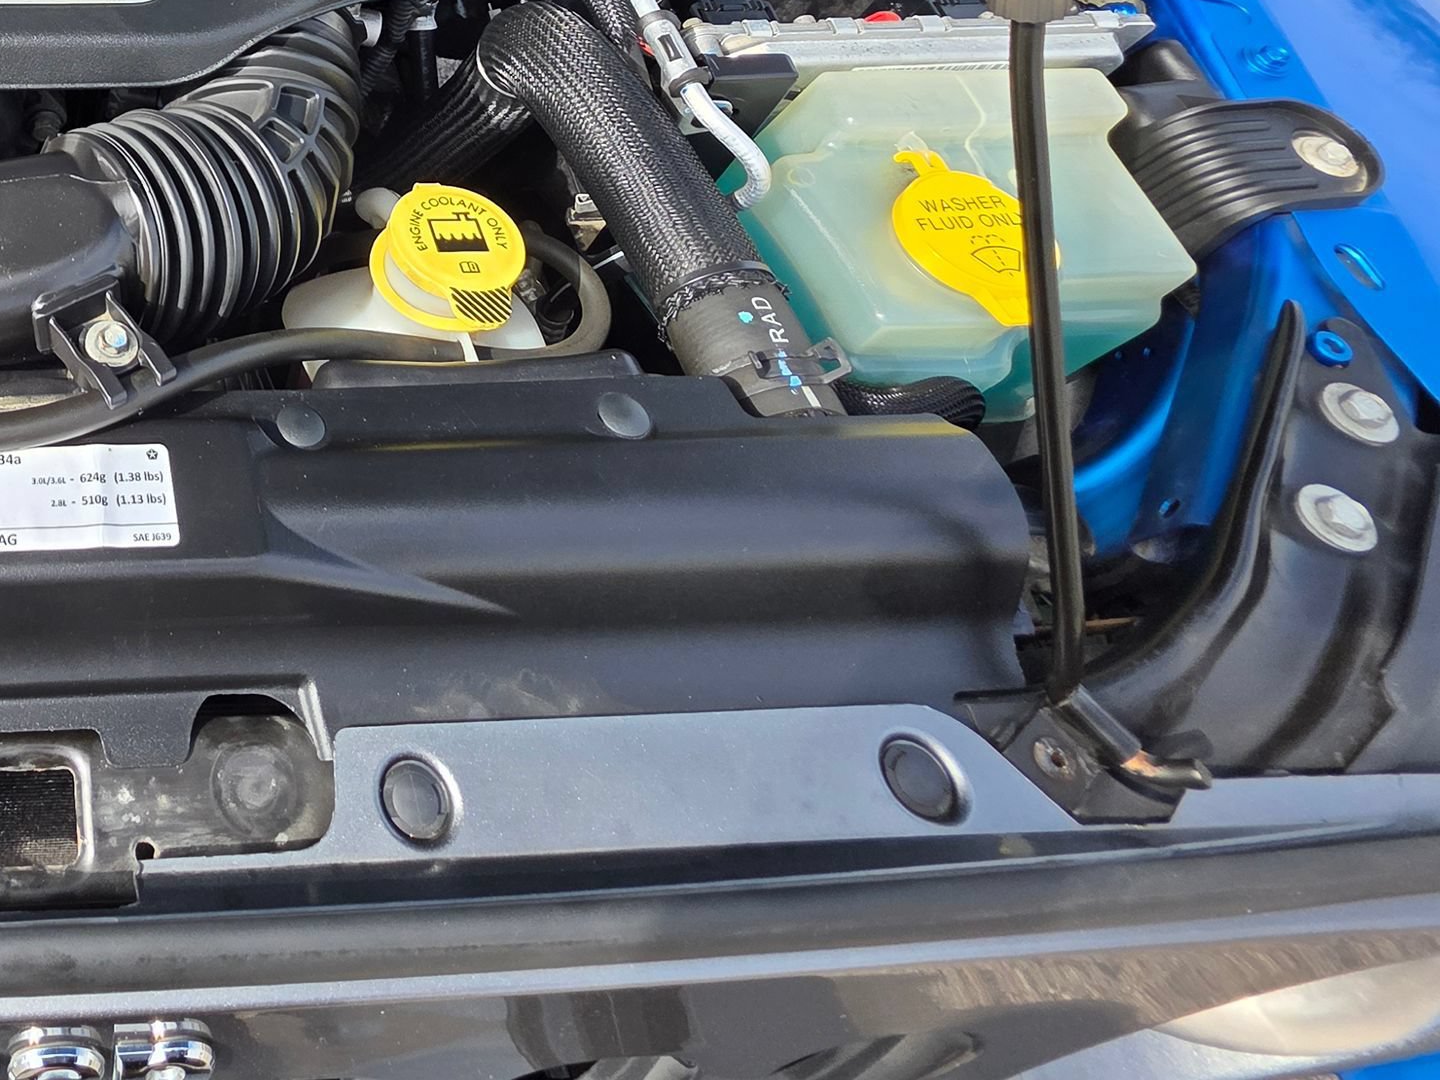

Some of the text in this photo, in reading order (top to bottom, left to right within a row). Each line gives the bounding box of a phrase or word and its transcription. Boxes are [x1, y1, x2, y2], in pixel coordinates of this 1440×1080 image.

[918, 195, 1006, 213] WASHER
[409, 196, 509, 252] ENGINE COOLANT ONLY
[916, 216, 975, 231] FLUID
[751, 296, 789, 344] RAD
[31, 476, 67, 486] 3.0L/3.6L
[79, 472, 107, 484] 624g
[113, 471, 142, 484] (1.38
[143, 470, 164, 483] lbs)
[81, 494, 108, 508] 510g
[116, 494, 144, 507] (1.13
[146, 493, 167, 506] lbs)
[133, 532, 172, 543] SAE J639
